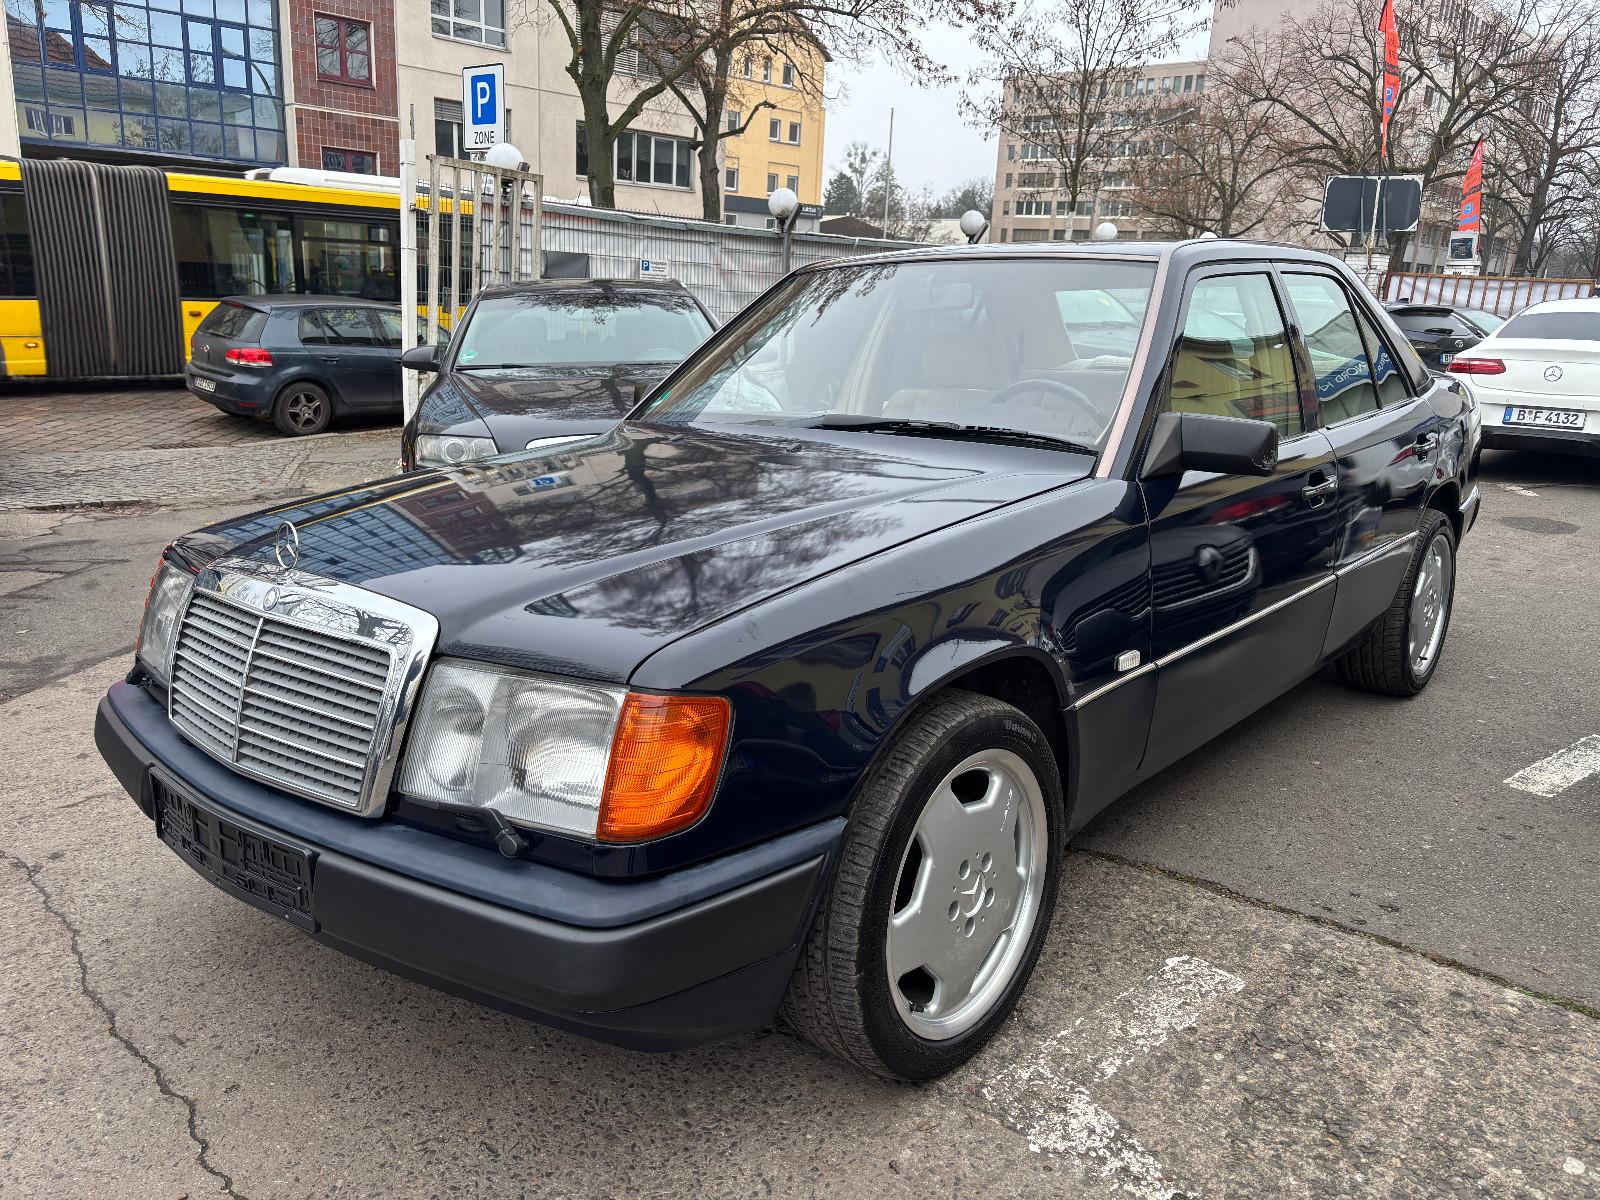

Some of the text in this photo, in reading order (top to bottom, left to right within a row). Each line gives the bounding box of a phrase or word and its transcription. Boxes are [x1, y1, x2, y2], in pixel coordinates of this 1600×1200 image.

[477, 81, 490, 118] P
[474, 131, 495, 144] ZONE
[1516, 409, 1580, 425] B F 4132
